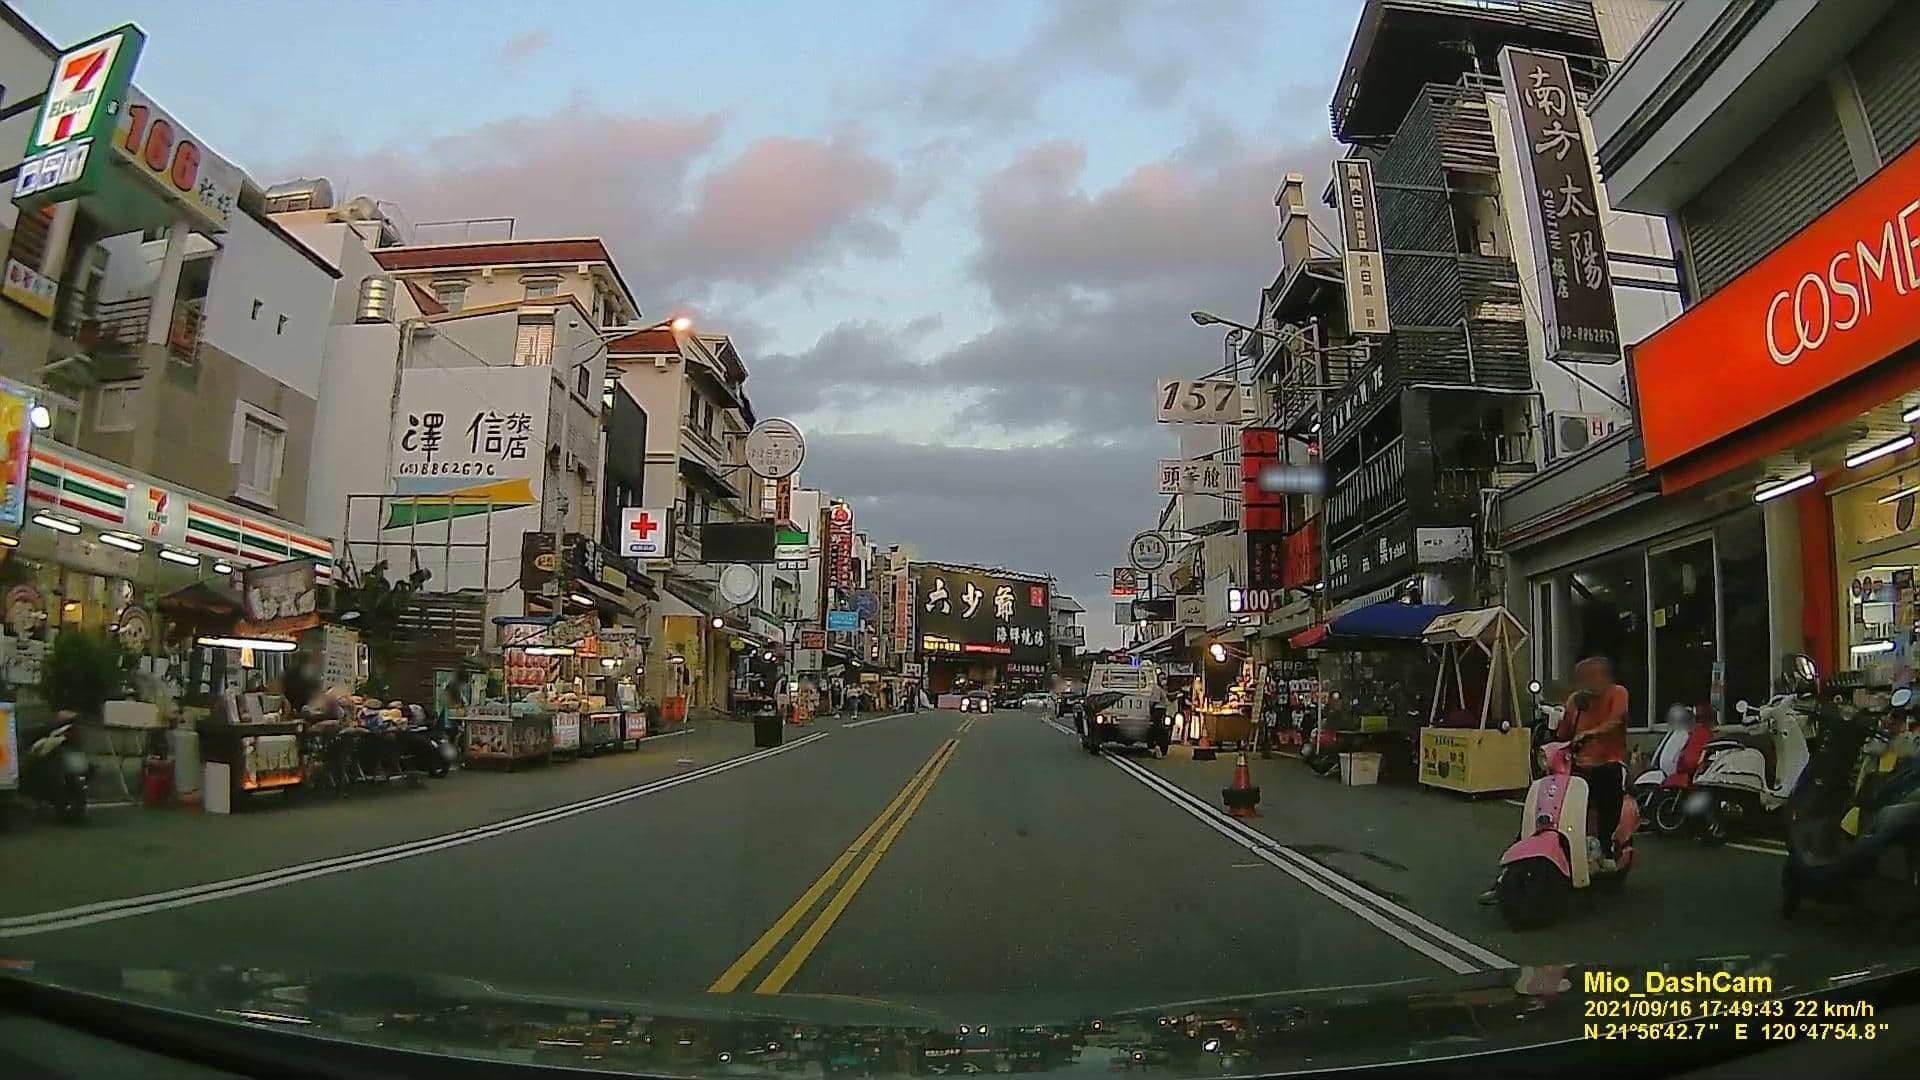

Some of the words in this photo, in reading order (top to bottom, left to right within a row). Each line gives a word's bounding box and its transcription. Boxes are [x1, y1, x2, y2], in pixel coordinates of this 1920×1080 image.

[124, 104, 200, 191] 166
[1525, 65, 1602, 290] 南方太陽
[1163, 381, 1236, 411] 157
